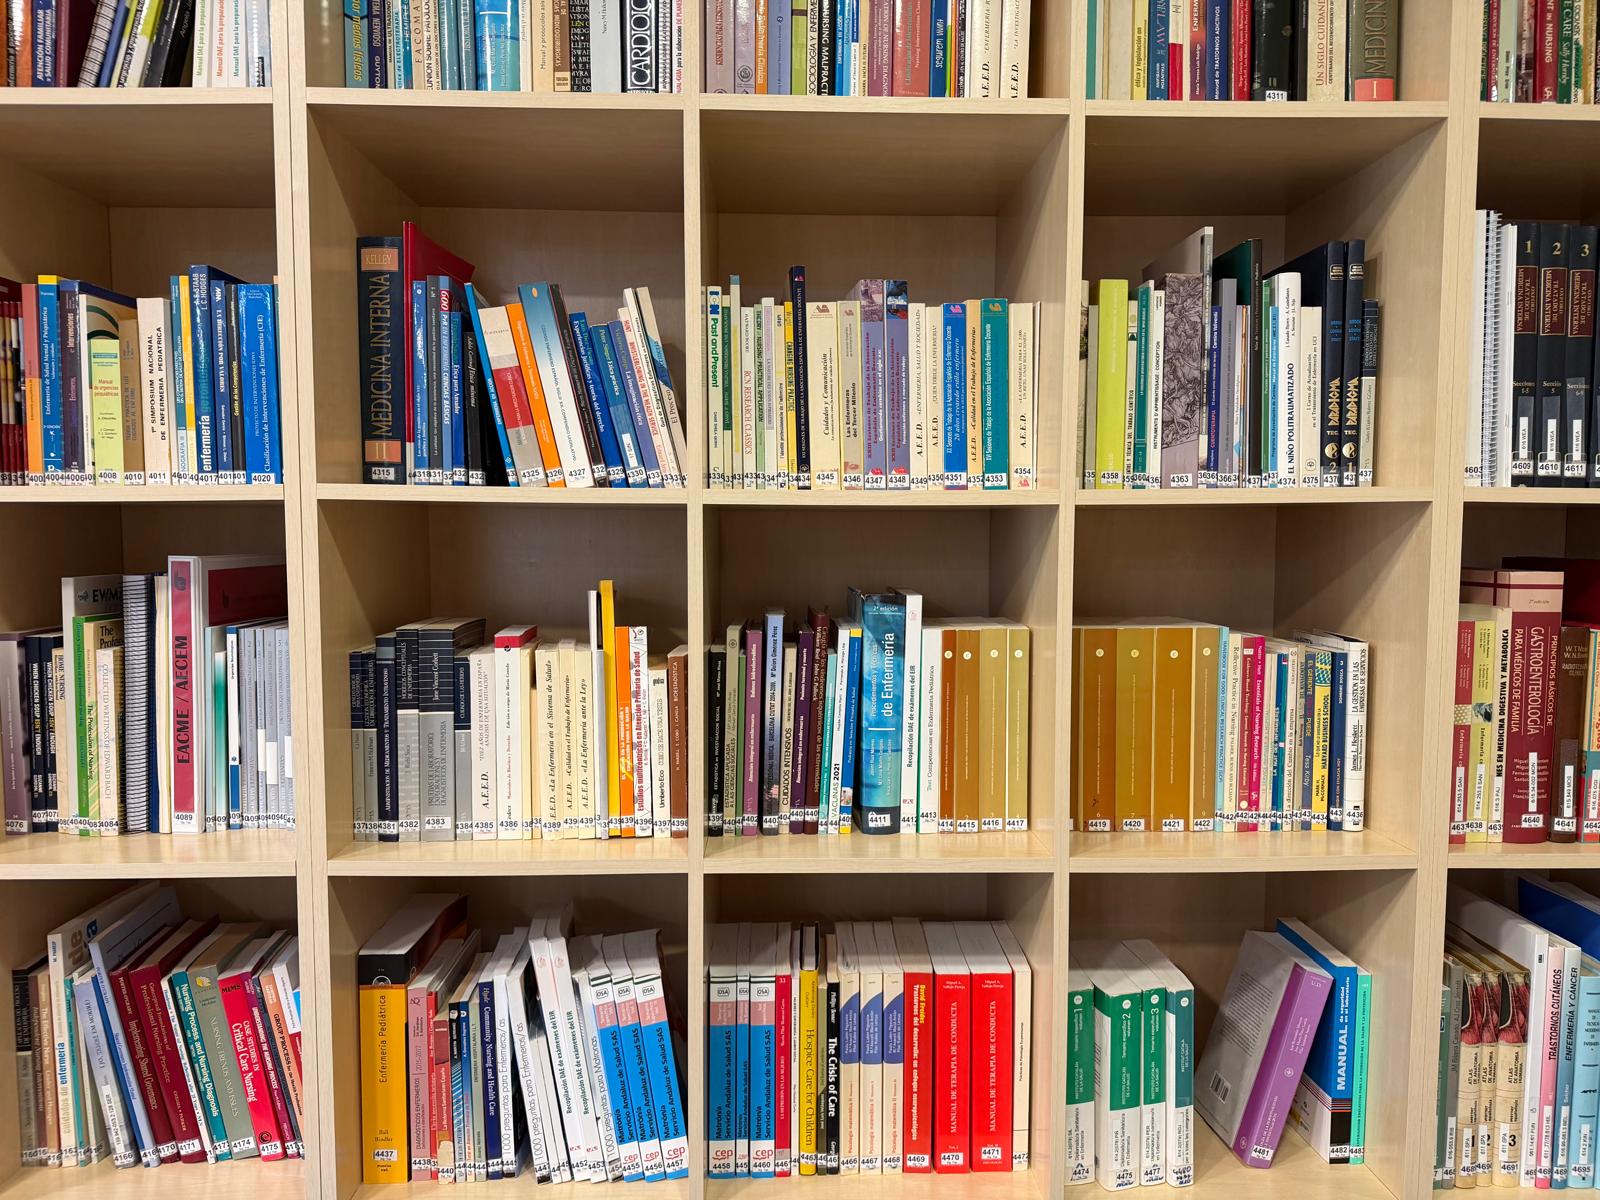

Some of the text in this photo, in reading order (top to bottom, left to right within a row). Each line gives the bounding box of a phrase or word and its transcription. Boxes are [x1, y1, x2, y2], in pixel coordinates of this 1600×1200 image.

[1267, 92, 1284, 100] 4311
[366, 254, 393, 263] KELLEY
[1526, 240, 1531, 253] 1
[1553, 242, 1561, 255] 2
[1581, 244, 1589, 256] 3
[369, 274, 392, 436] MEDICINA INTERNA
[711, 338, 719, 355] and
[260, 368, 265, 376] de
[744, 386, 752, 421] RESEARCH
[161, 431, 166, 440] DE
[199, 416, 212, 471] enfermería
[1286, 444, 1294, 463] NIÑO
[372, 468, 392, 476] 4315
[881, 633, 895, 716] de Enfermería
[1511, 629, 1524, 732] PARA MÉDICOS DE FAMILIA
[1527, 627, 1544, 734] GASTROENTEROLOGÍA
[1547, 635, 1558, 726] PRINCIPIOS BÁSICOS DE
[175, 636, 189, 763] EACME AECEM
[782, 728, 792, 805] CUIDADOS INTENSIVOS
[831, 782, 839, 817] VACUNAS
[869, 816, 889, 824] 4411
[1569, 967, 1578, 1000] CÁNCER
[484, 1007, 492, 1042] Community
[1548, 969, 1561, 1060] TRASTORNOS CUTÁNEOS
[181, 984, 219, 1116] Nursing Process and Nursing Diagnosis
[378, 995, 387, 1083] Enfermería Pediátrica
[951, 1042, 957, 1055] DE
[1565, 1011, 1575, 1061] ENFERMERÍA
[56, 1042, 67, 1084] enfermería
[232, 1023, 257, 1102] Critical Care Nursing
[485, 1044, 493, 1067] Nursing
[765, 1068, 771, 1077] de
[1337, 1025, 1347, 1090] MANUAL
[804, 1029, 815, 1145] Hospice Care for Children
[828, 1037, 837, 1117] The Crisis of Care
[951, 1087, 957, 1099] DE
[526, 1079, 544, 1160] 1000 preguntas para
